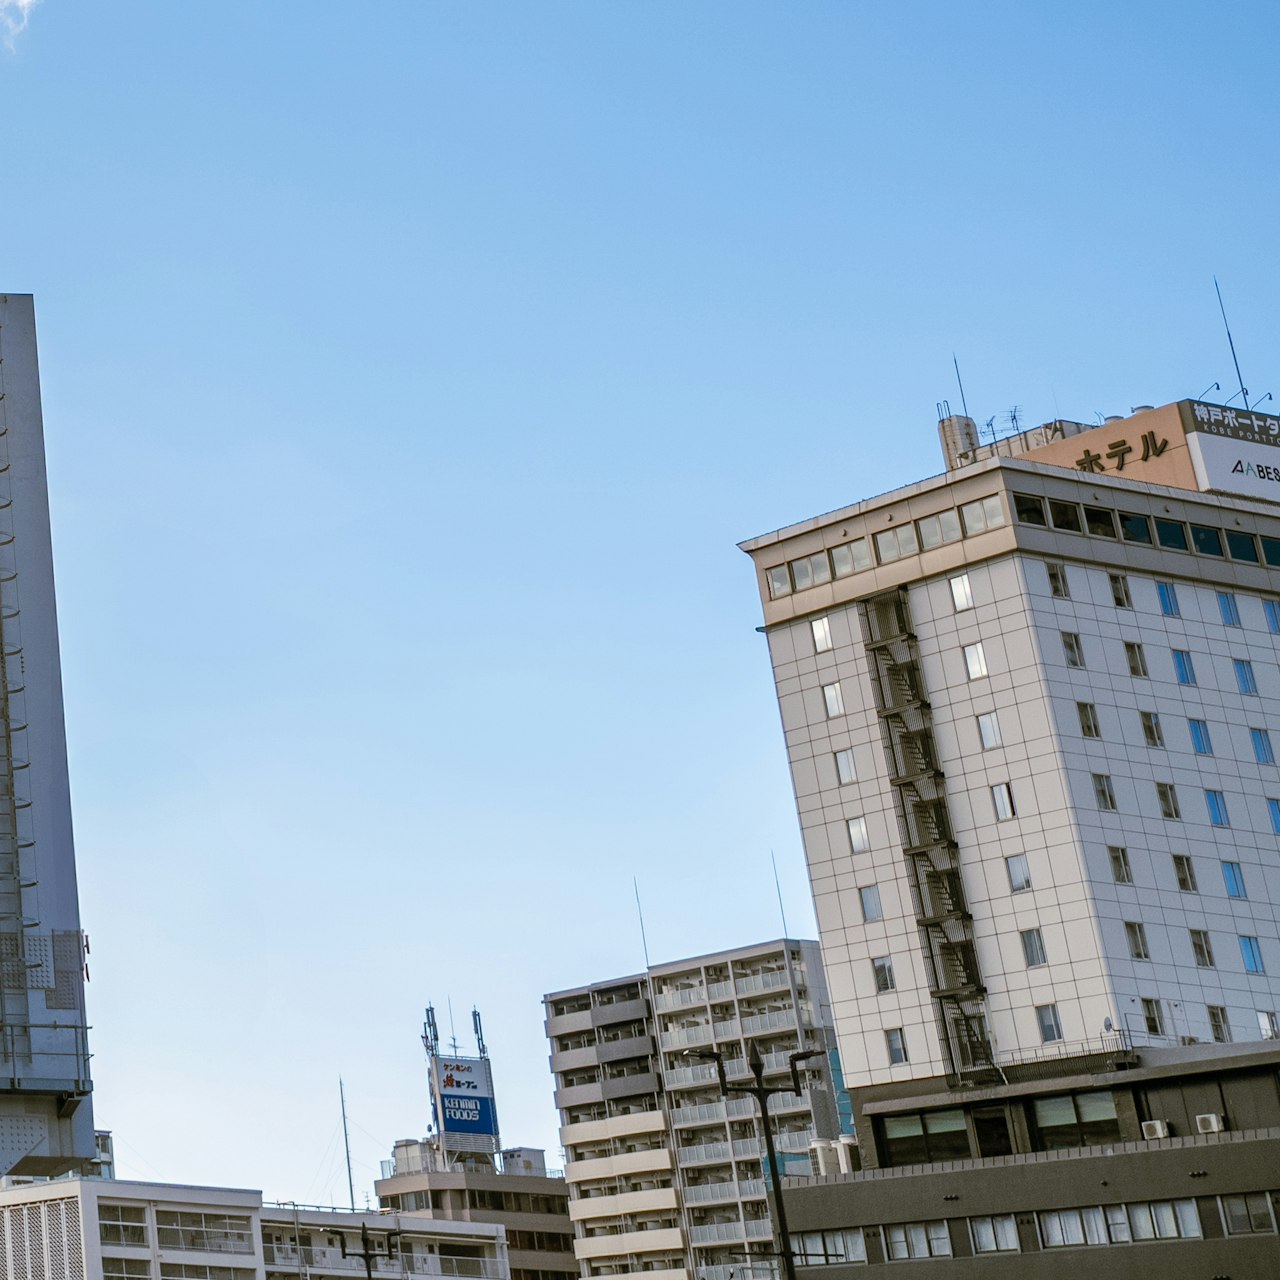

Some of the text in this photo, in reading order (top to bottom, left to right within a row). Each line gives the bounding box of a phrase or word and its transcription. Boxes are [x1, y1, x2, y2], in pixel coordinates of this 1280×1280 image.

[1193, 403, 1280, 435] 神戸ポートタ
[1203, 423, 1232, 436] KOBE
[1075, 430, 1168, 473] ホテル
[444, 1097, 480, 1110] KENMIN
[445, 1109, 479, 1121] FOODS
